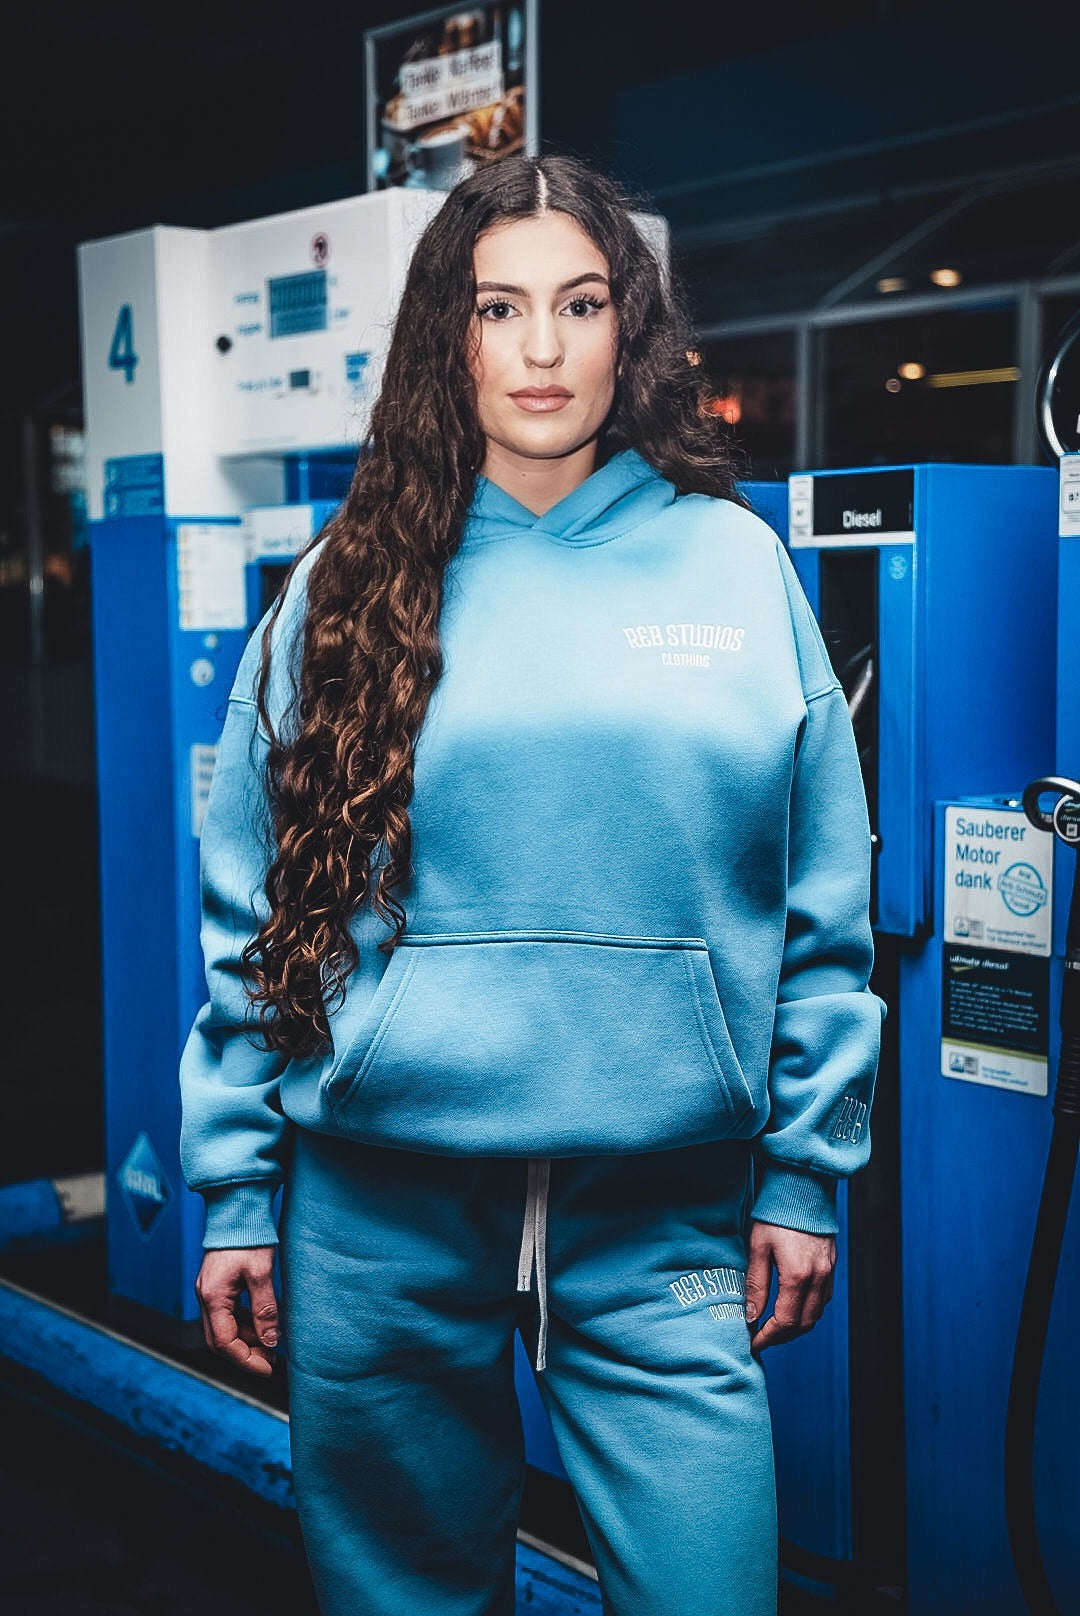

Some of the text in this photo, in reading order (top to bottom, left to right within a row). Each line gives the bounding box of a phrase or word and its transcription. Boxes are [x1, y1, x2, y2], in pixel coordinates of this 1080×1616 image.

[109, 303, 138, 384] 4
[842, 508, 882, 529] Diesel
[666, 623, 746, 652] STUDIOS
[661, 652, 711, 668] CLOTHING
[955, 817, 1026, 842] Sauberer
[955, 843, 1001, 866] Motor
[954, 869, 993, 890] dank
